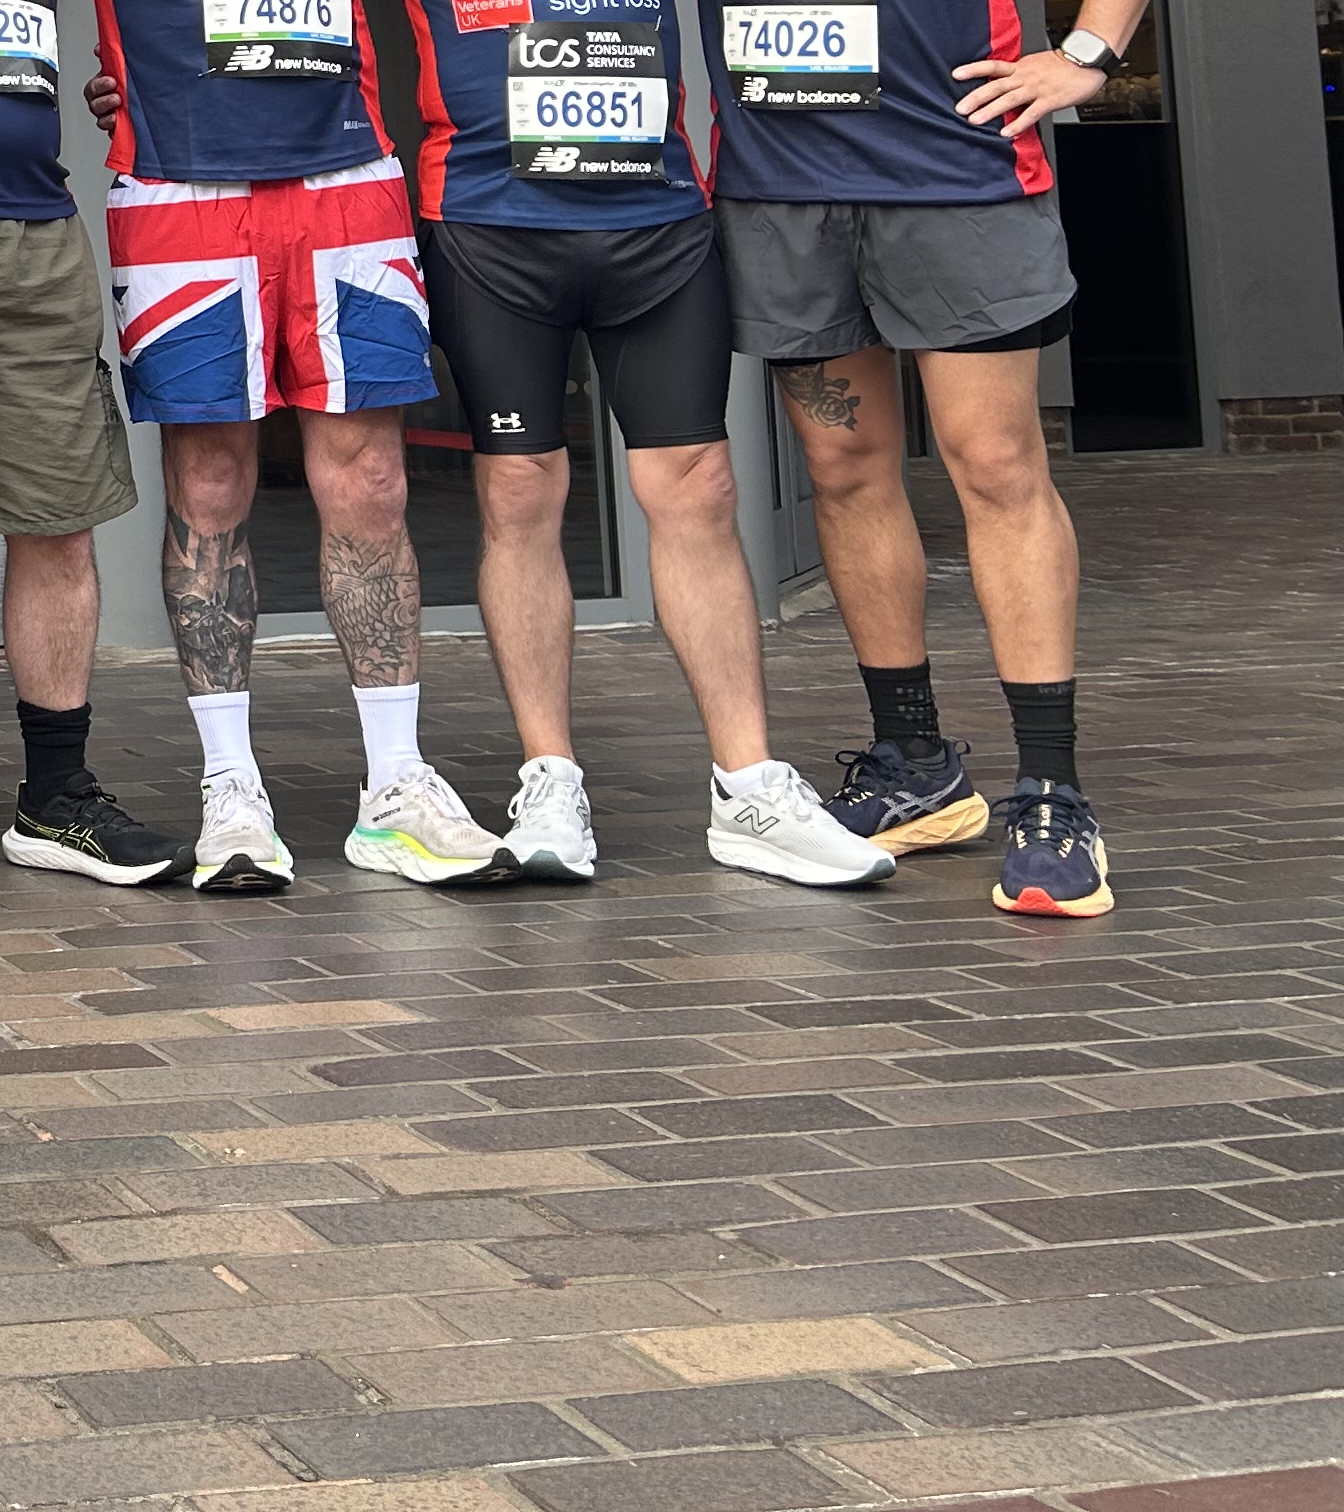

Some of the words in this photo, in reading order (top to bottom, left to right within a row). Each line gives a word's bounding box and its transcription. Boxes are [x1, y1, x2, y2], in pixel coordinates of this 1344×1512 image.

[461, 14, 481, 27] UK
[586, 32, 621, 42] TATA
[739, 20, 846, 57] 74026
[520, 33, 581, 68] tcs
[586, 44, 655, 57] CONSULTANCY
[275, 58, 302, 70] new
[303, 57, 342, 74] balance
[587, 57, 636, 69] SERVICES
[768, 91, 796, 103] new
[797, 90, 861, 104] balance
[537, 91, 642, 128] 66851
[580, 161, 609, 172] new
[611, 159, 651, 173] balance
